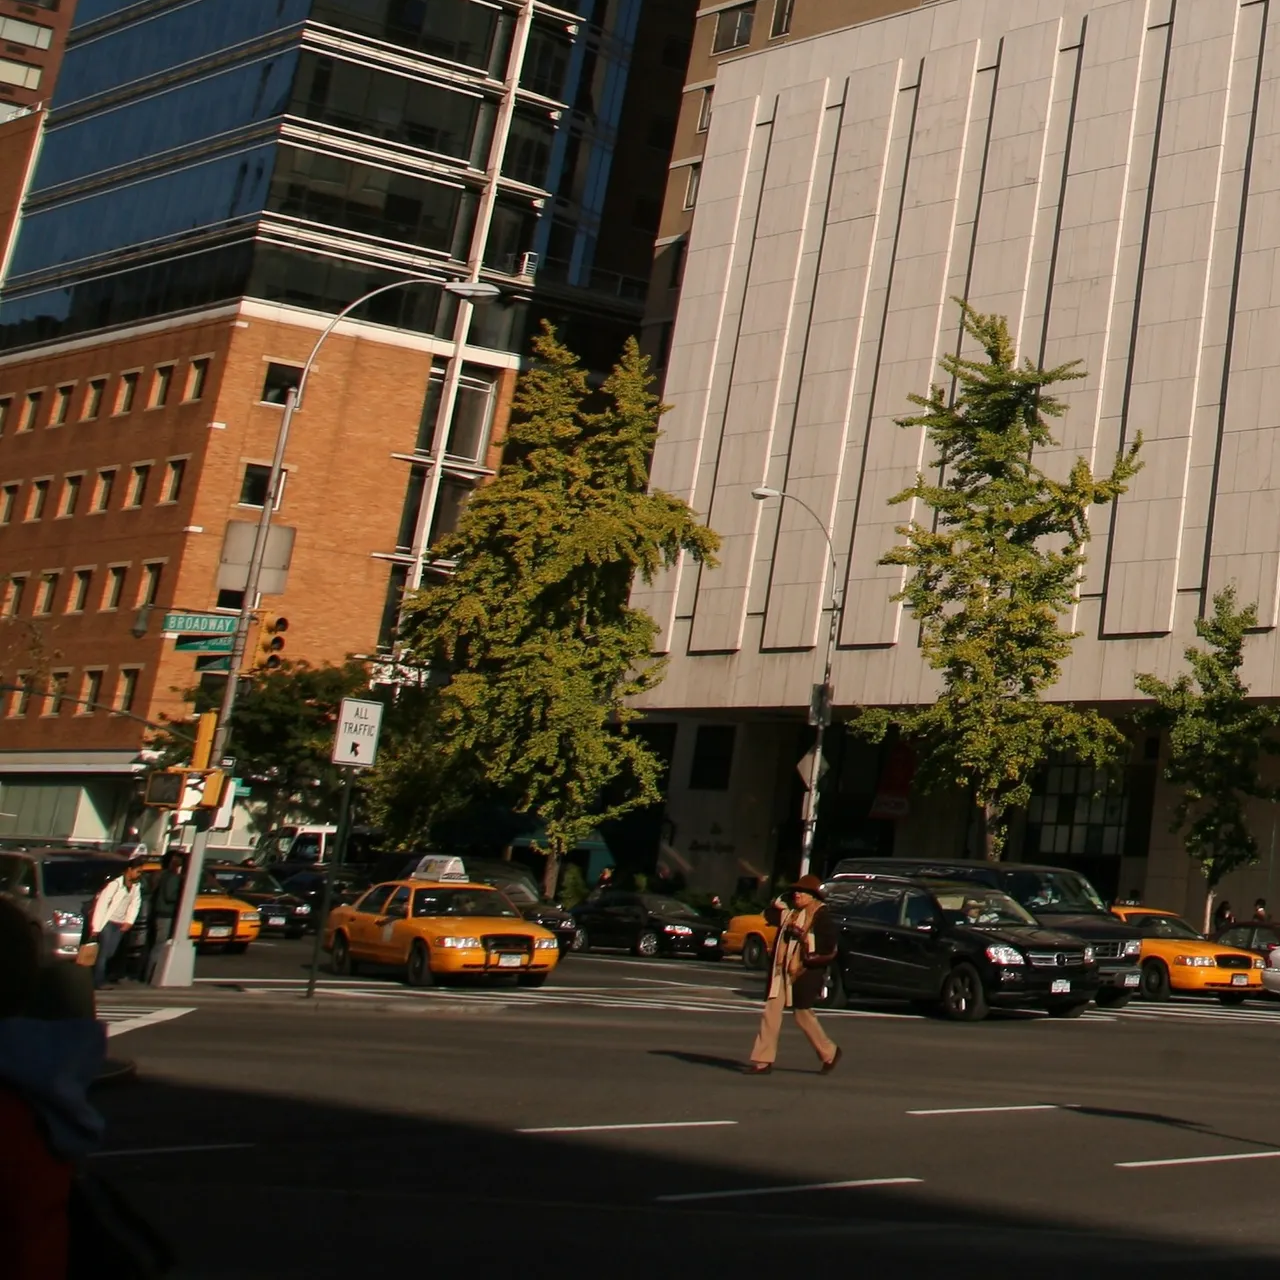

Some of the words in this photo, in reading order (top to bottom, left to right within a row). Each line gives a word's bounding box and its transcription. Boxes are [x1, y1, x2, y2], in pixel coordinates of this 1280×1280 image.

[168, 616, 232, 631] BROADWAY
[354, 707, 369, 720] ALL
[344, 722, 375, 737] TRAFFIC
